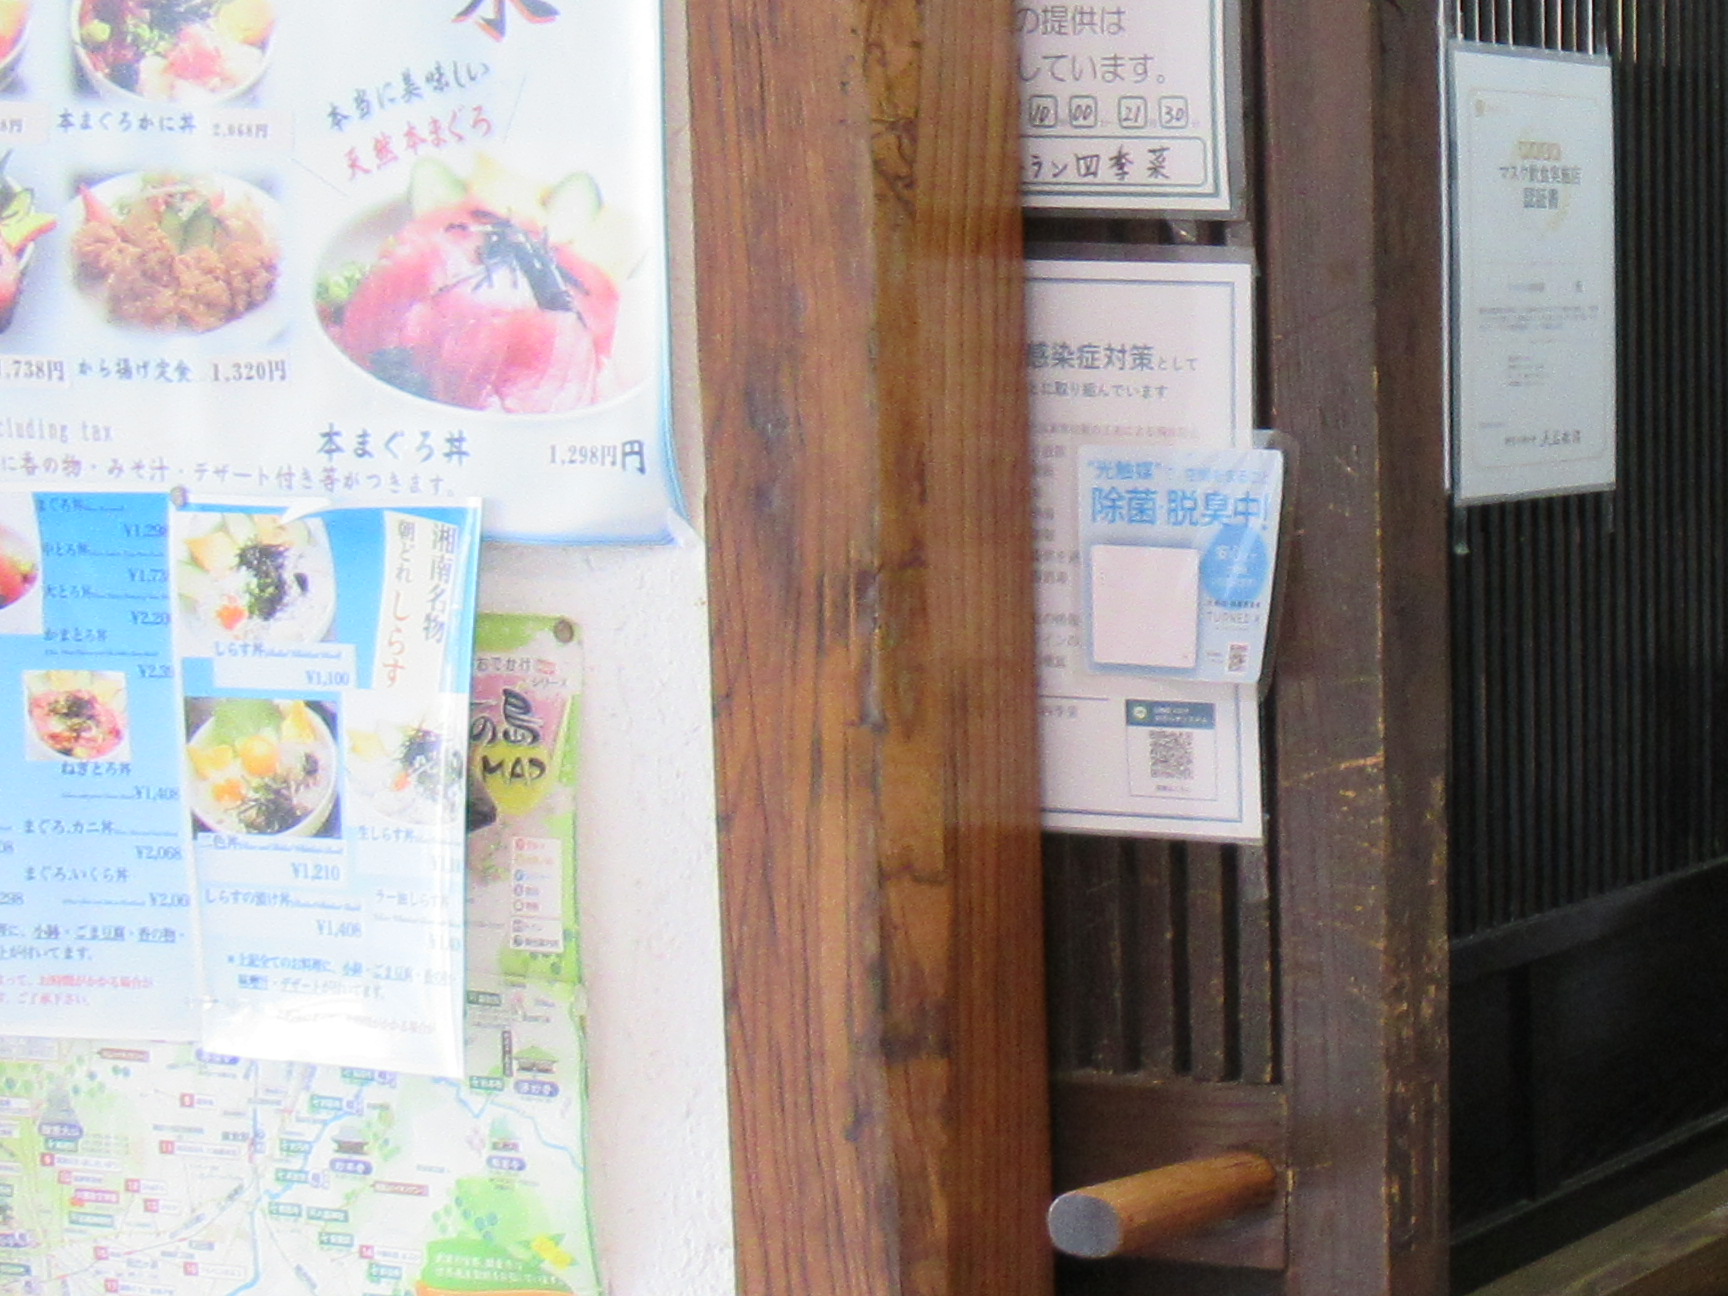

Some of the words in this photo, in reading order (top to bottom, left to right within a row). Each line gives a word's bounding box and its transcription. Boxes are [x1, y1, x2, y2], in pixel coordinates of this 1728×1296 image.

[316, 422, 471, 467] 本まぐろ丼
